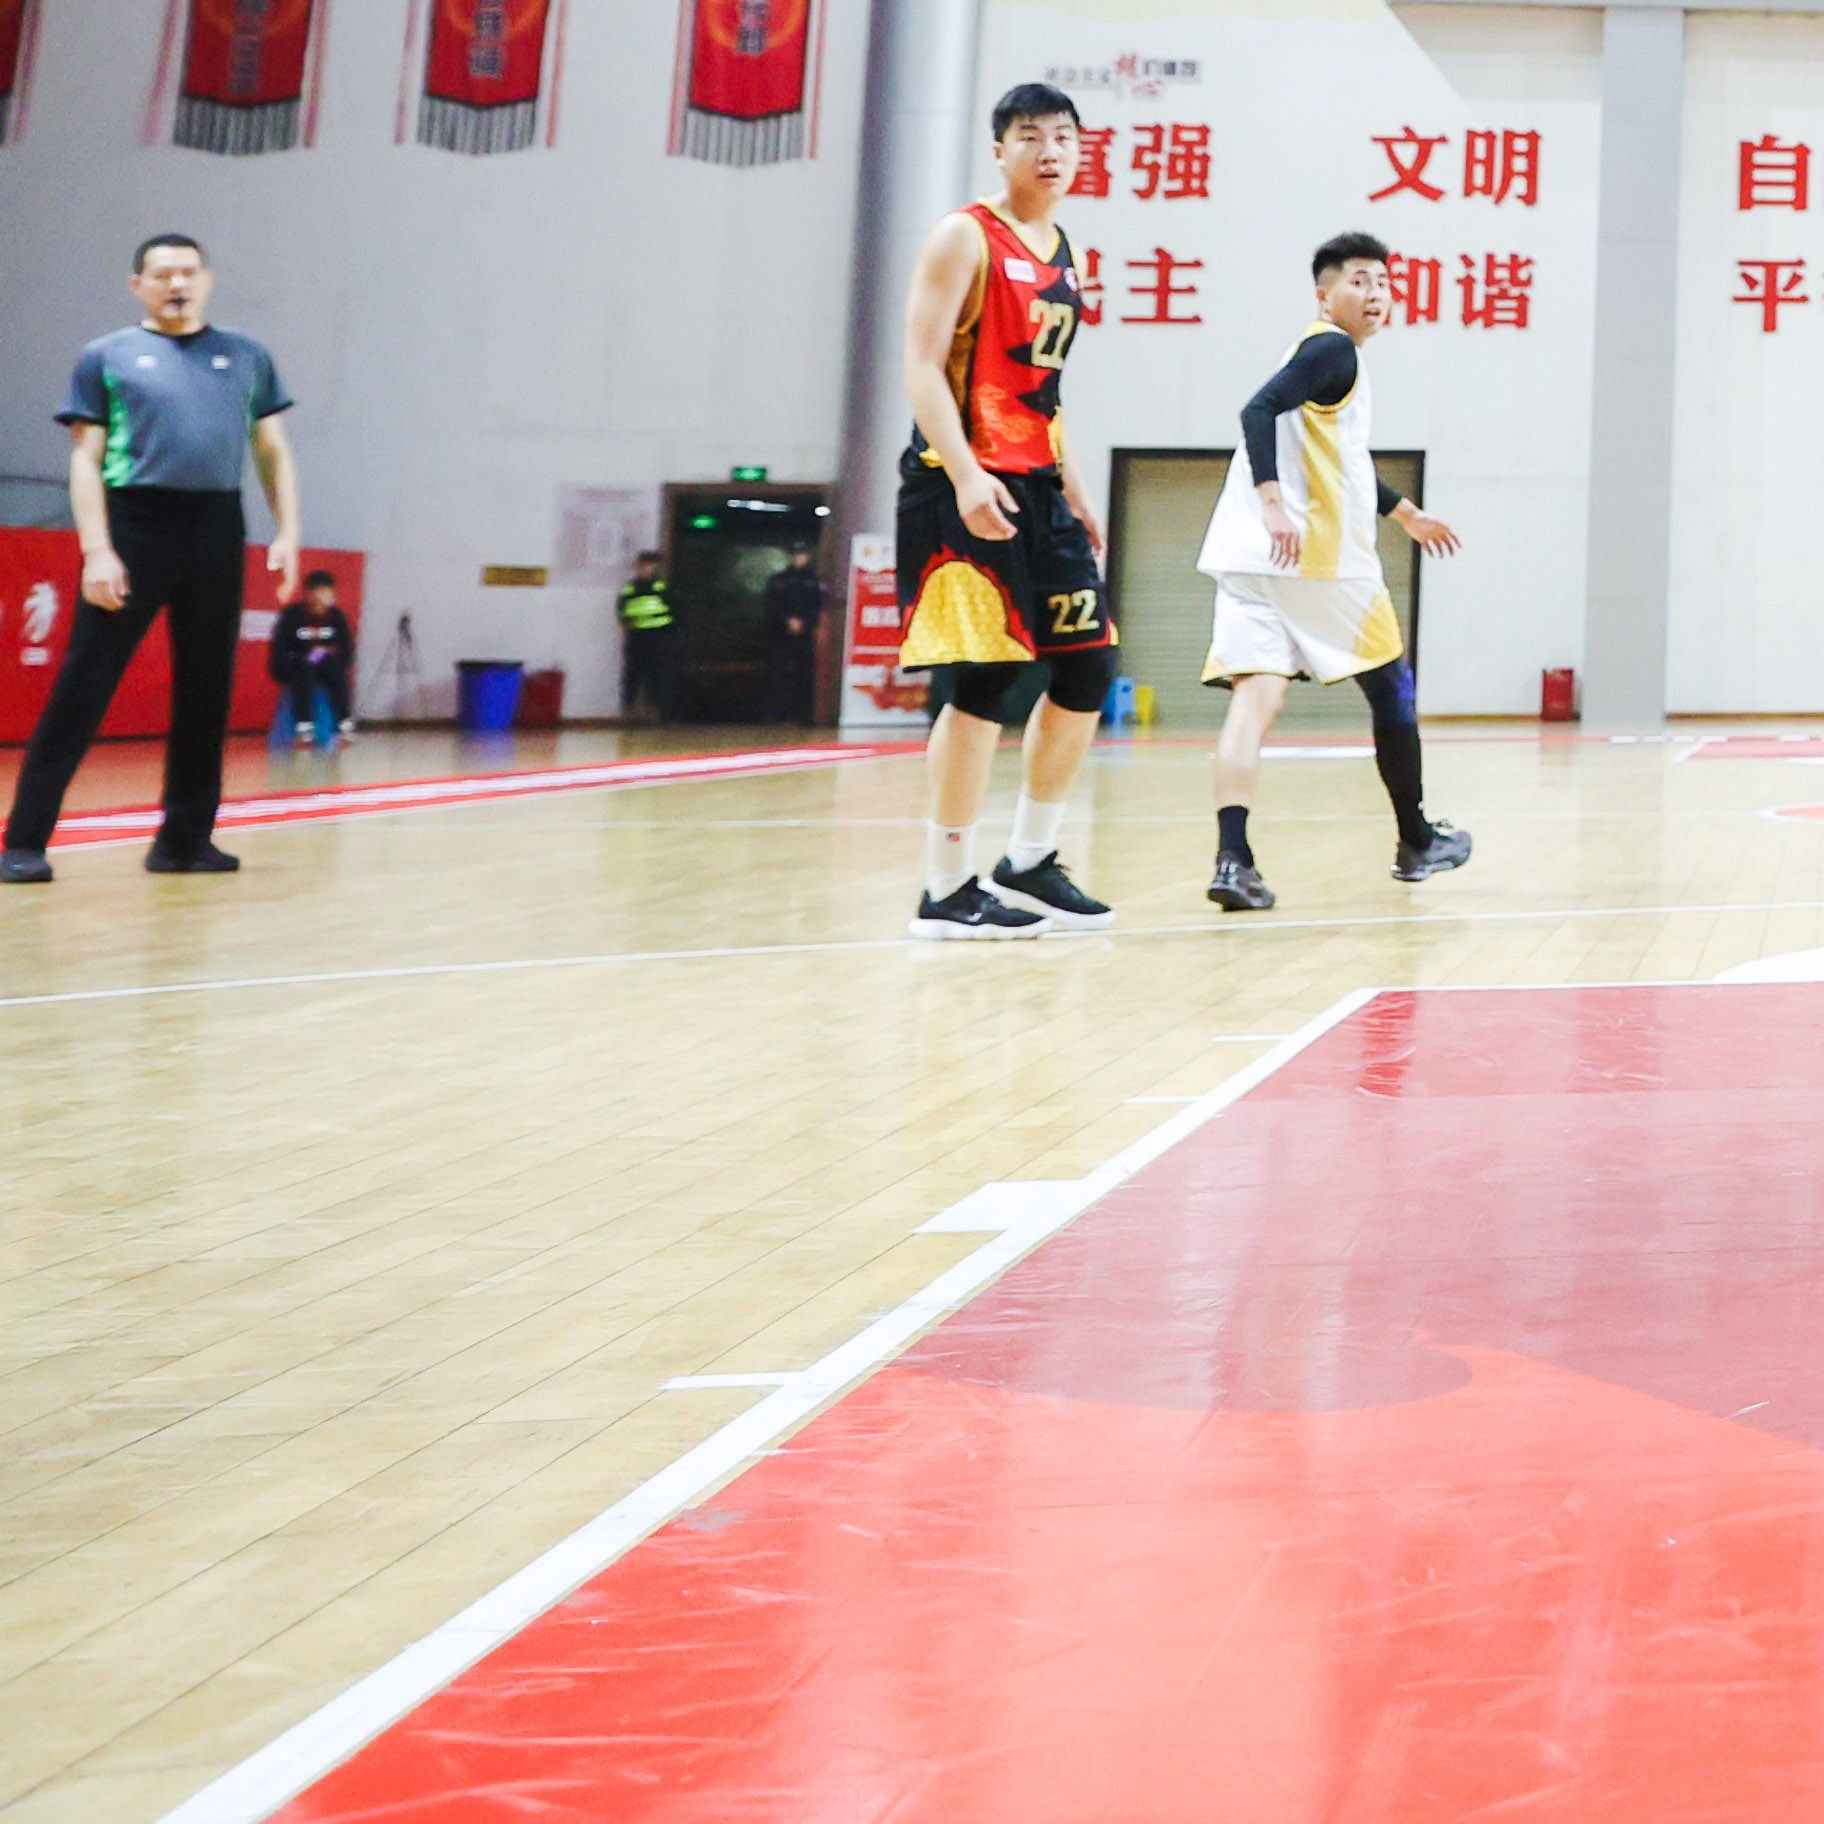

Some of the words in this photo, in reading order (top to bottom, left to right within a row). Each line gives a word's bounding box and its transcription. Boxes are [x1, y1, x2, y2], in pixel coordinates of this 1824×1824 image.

[1369, 126, 1543, 207] 文明
[1080, 247, 1204, 327] 主
[1382, 251, 1535, 331] 和谐
[1047, 588, 1101, 635] 22
